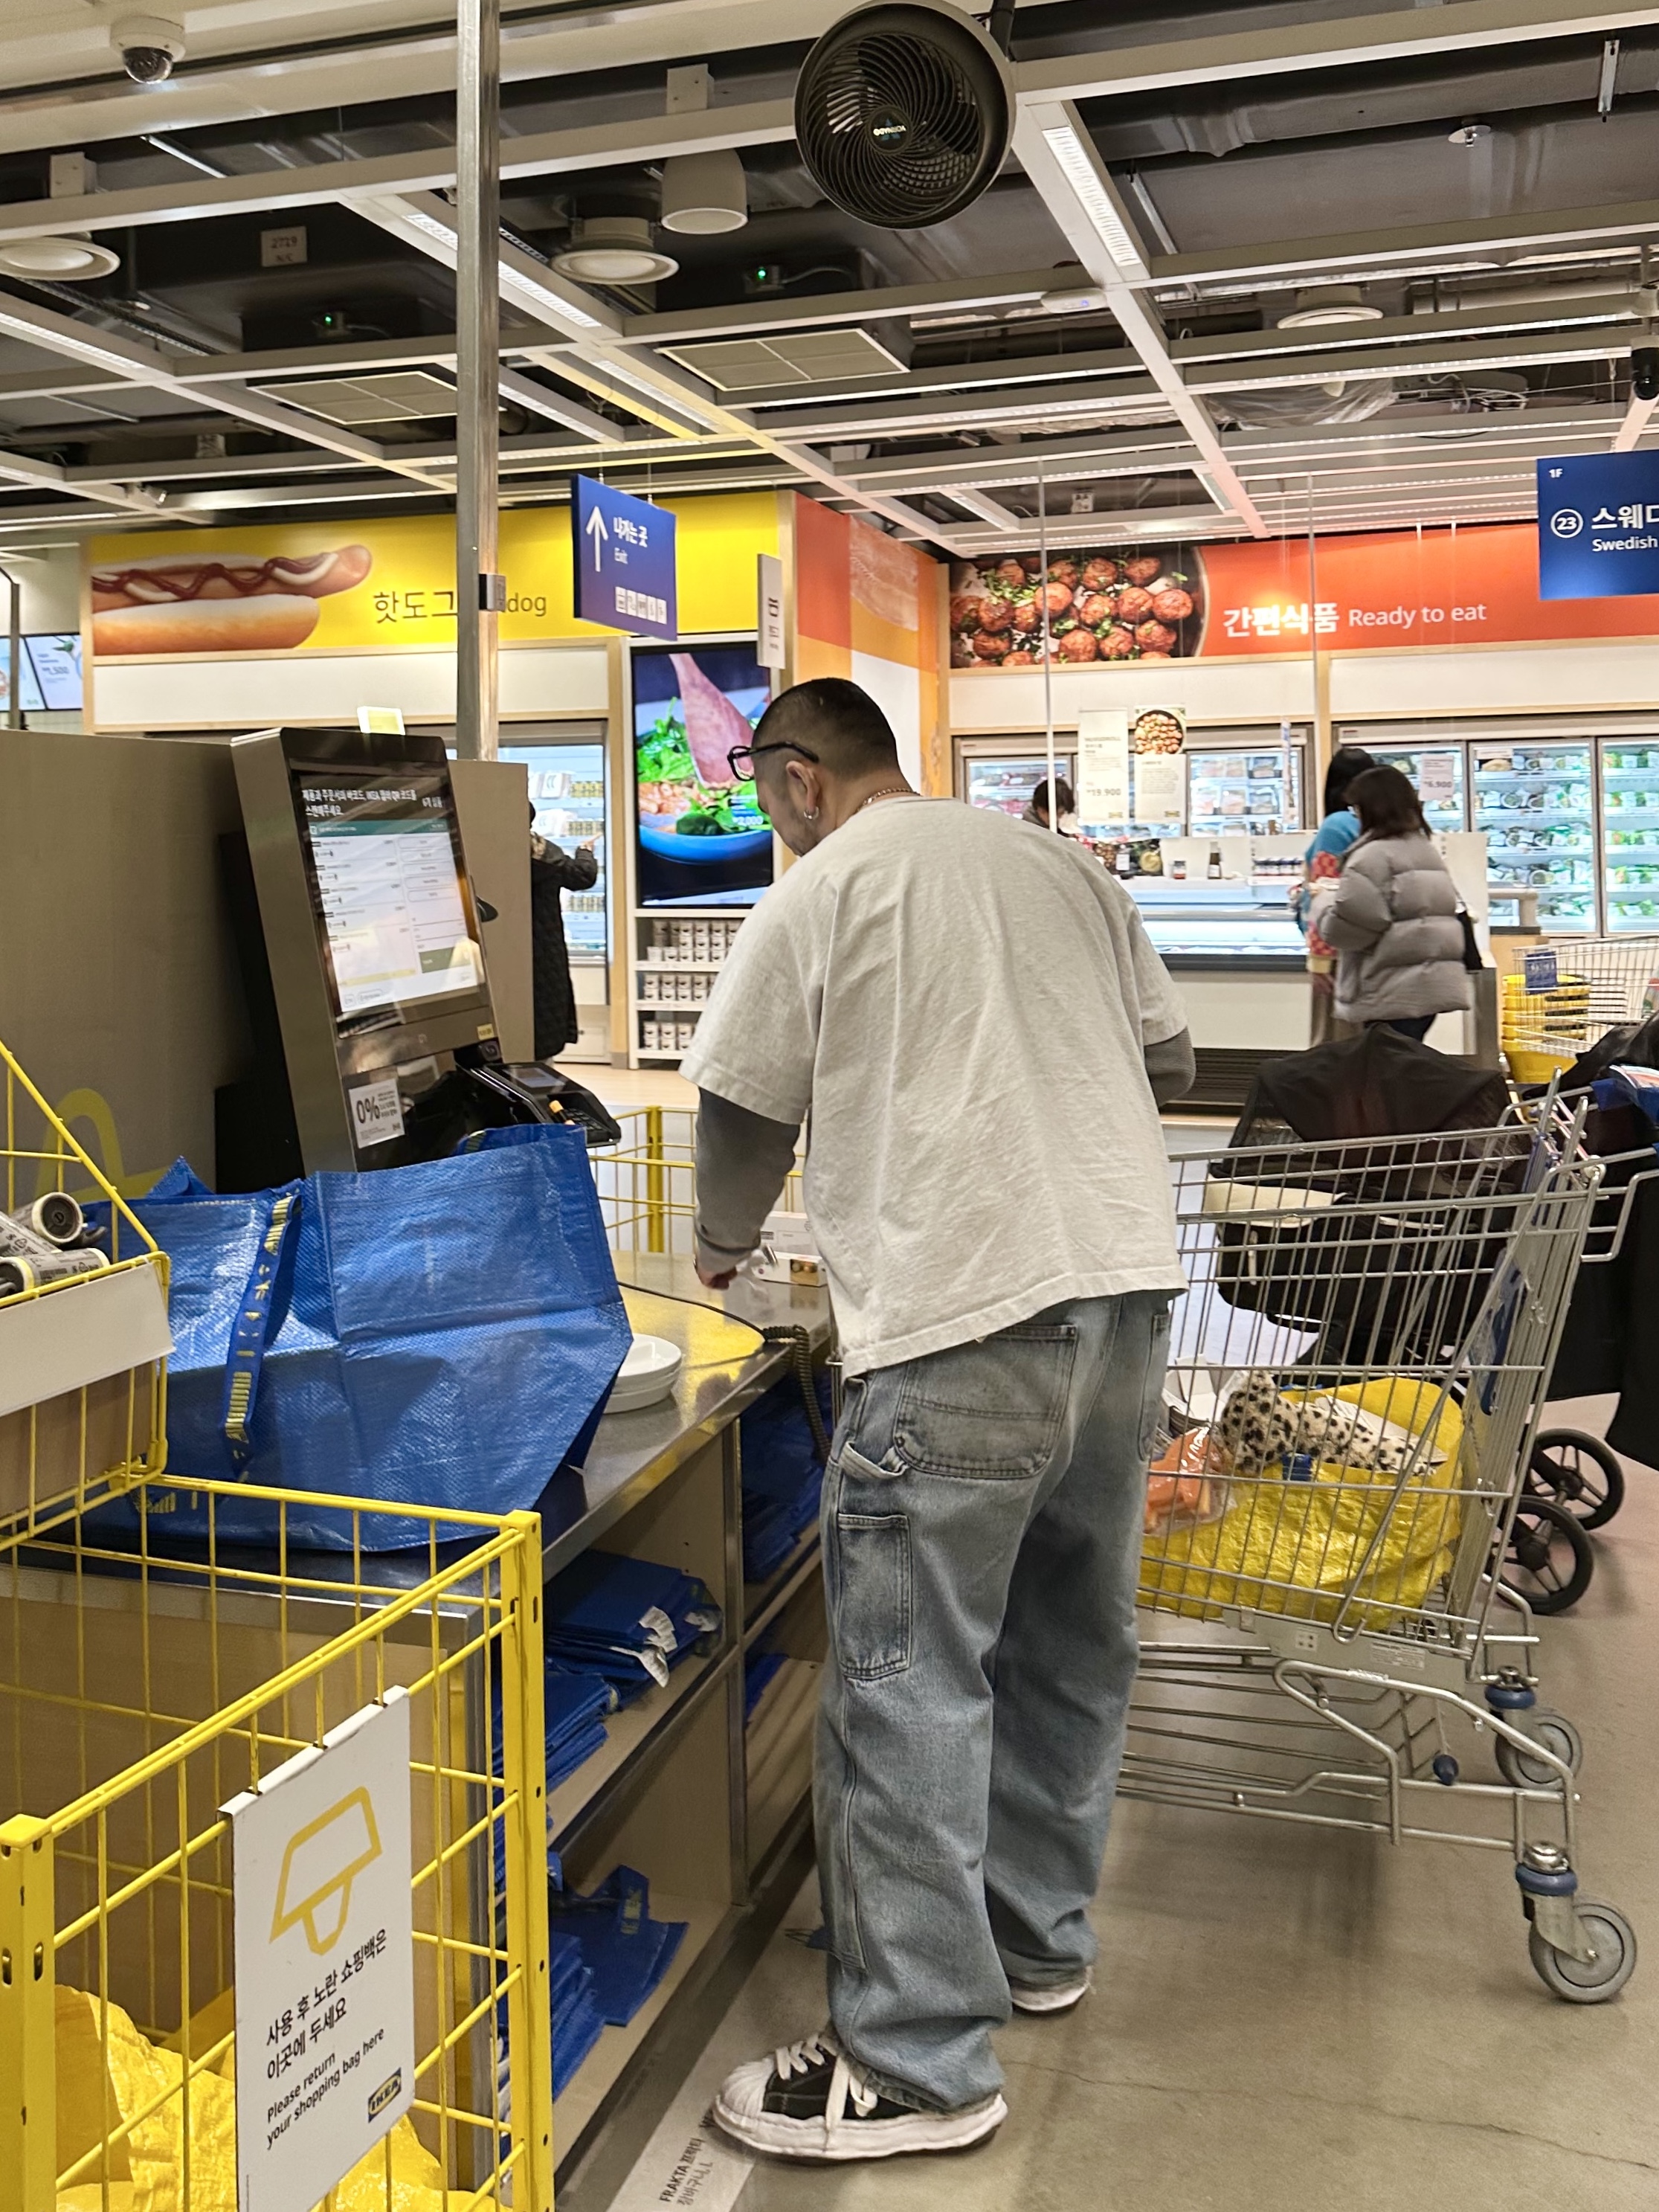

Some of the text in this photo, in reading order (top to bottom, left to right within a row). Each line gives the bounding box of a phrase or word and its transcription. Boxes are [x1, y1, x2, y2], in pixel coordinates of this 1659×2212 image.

[1548, 468, 1563, 478] 1F
[1556, 516, 1577, 530] 23
[614, 547, 628, 565] Exit
[1592, 536, 1658, 552] Swedish
[373, 591, 458, 623] 핫도그
[1223, 602, 1339, 637] 간편식품
[1348, 603, 1486, 629] Ready to eat
[356, 1096, 380, 1124] 0%
[266, 1929, 386, 2045] 사용 후 노란 쇼핑백은
[268, 1997, 347, 2079] 이곳에 두세요
[267, 2028, 384, 2150] your shopping bag here
[268, 2053, 335, 2123] Please return
[371, 2077, 400, 2113] IKEA
[660, 2165, 689, 2202] FRAKTA
